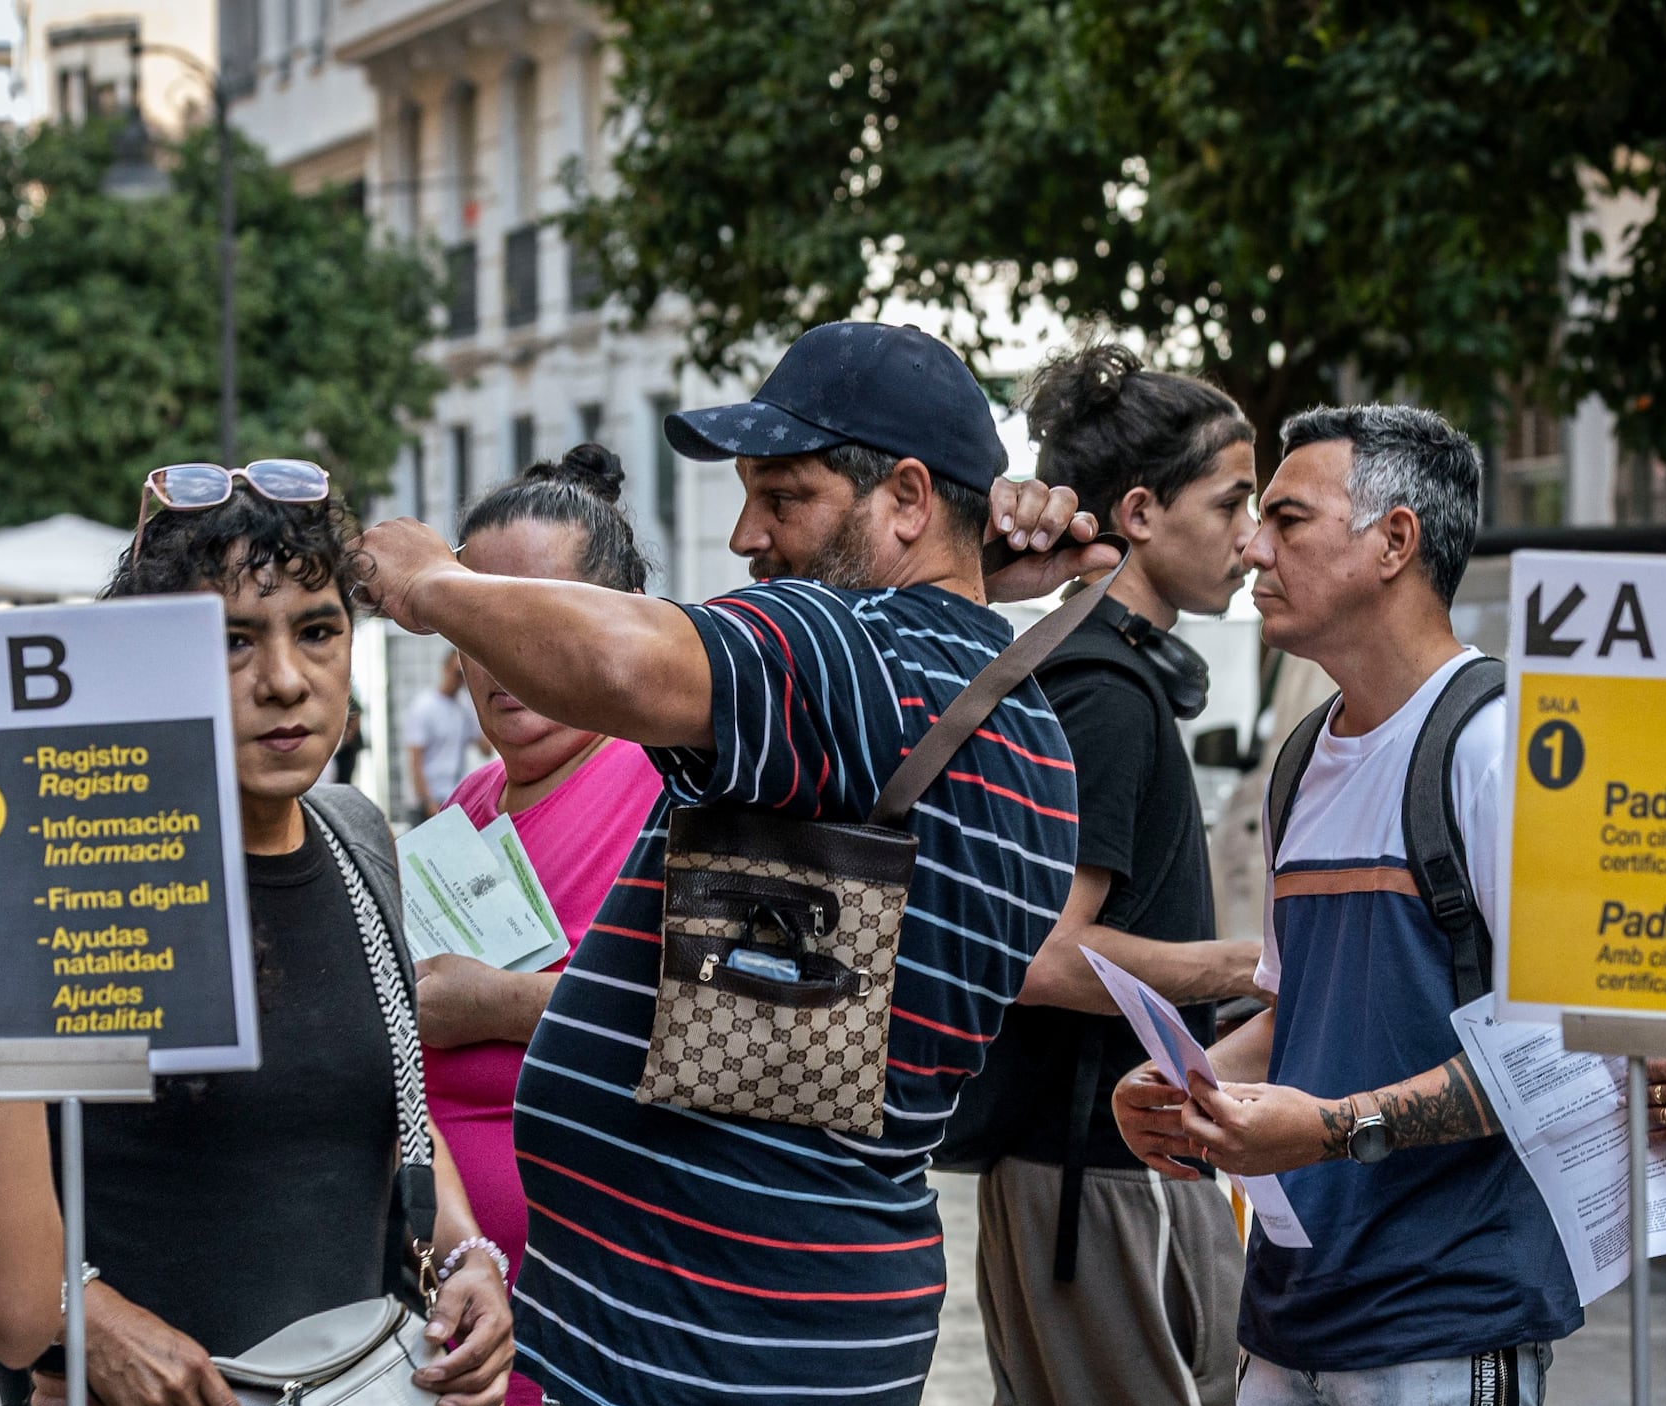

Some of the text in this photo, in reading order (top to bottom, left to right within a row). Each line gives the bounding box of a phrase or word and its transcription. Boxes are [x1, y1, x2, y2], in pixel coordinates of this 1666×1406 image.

[1598, 582, 1654, 659] A
[6, 635, 73, 711] B
[1538, 696, 1579, 715] SALA
[1542, 728, 1565, 781] 1
[39, 772, 150, 800] Registre
[1601, 824, 1641, 848] Con
[44, 839, 185, 866] Informació
[129, 881, 210, 911] digital
[53, 948, 174, 975] natalidad
[1596, 945, 1643, 968] Amb
[52, 984, 143, 1010] Ajudes
[56, 1007, 164, 1034] natalitat
